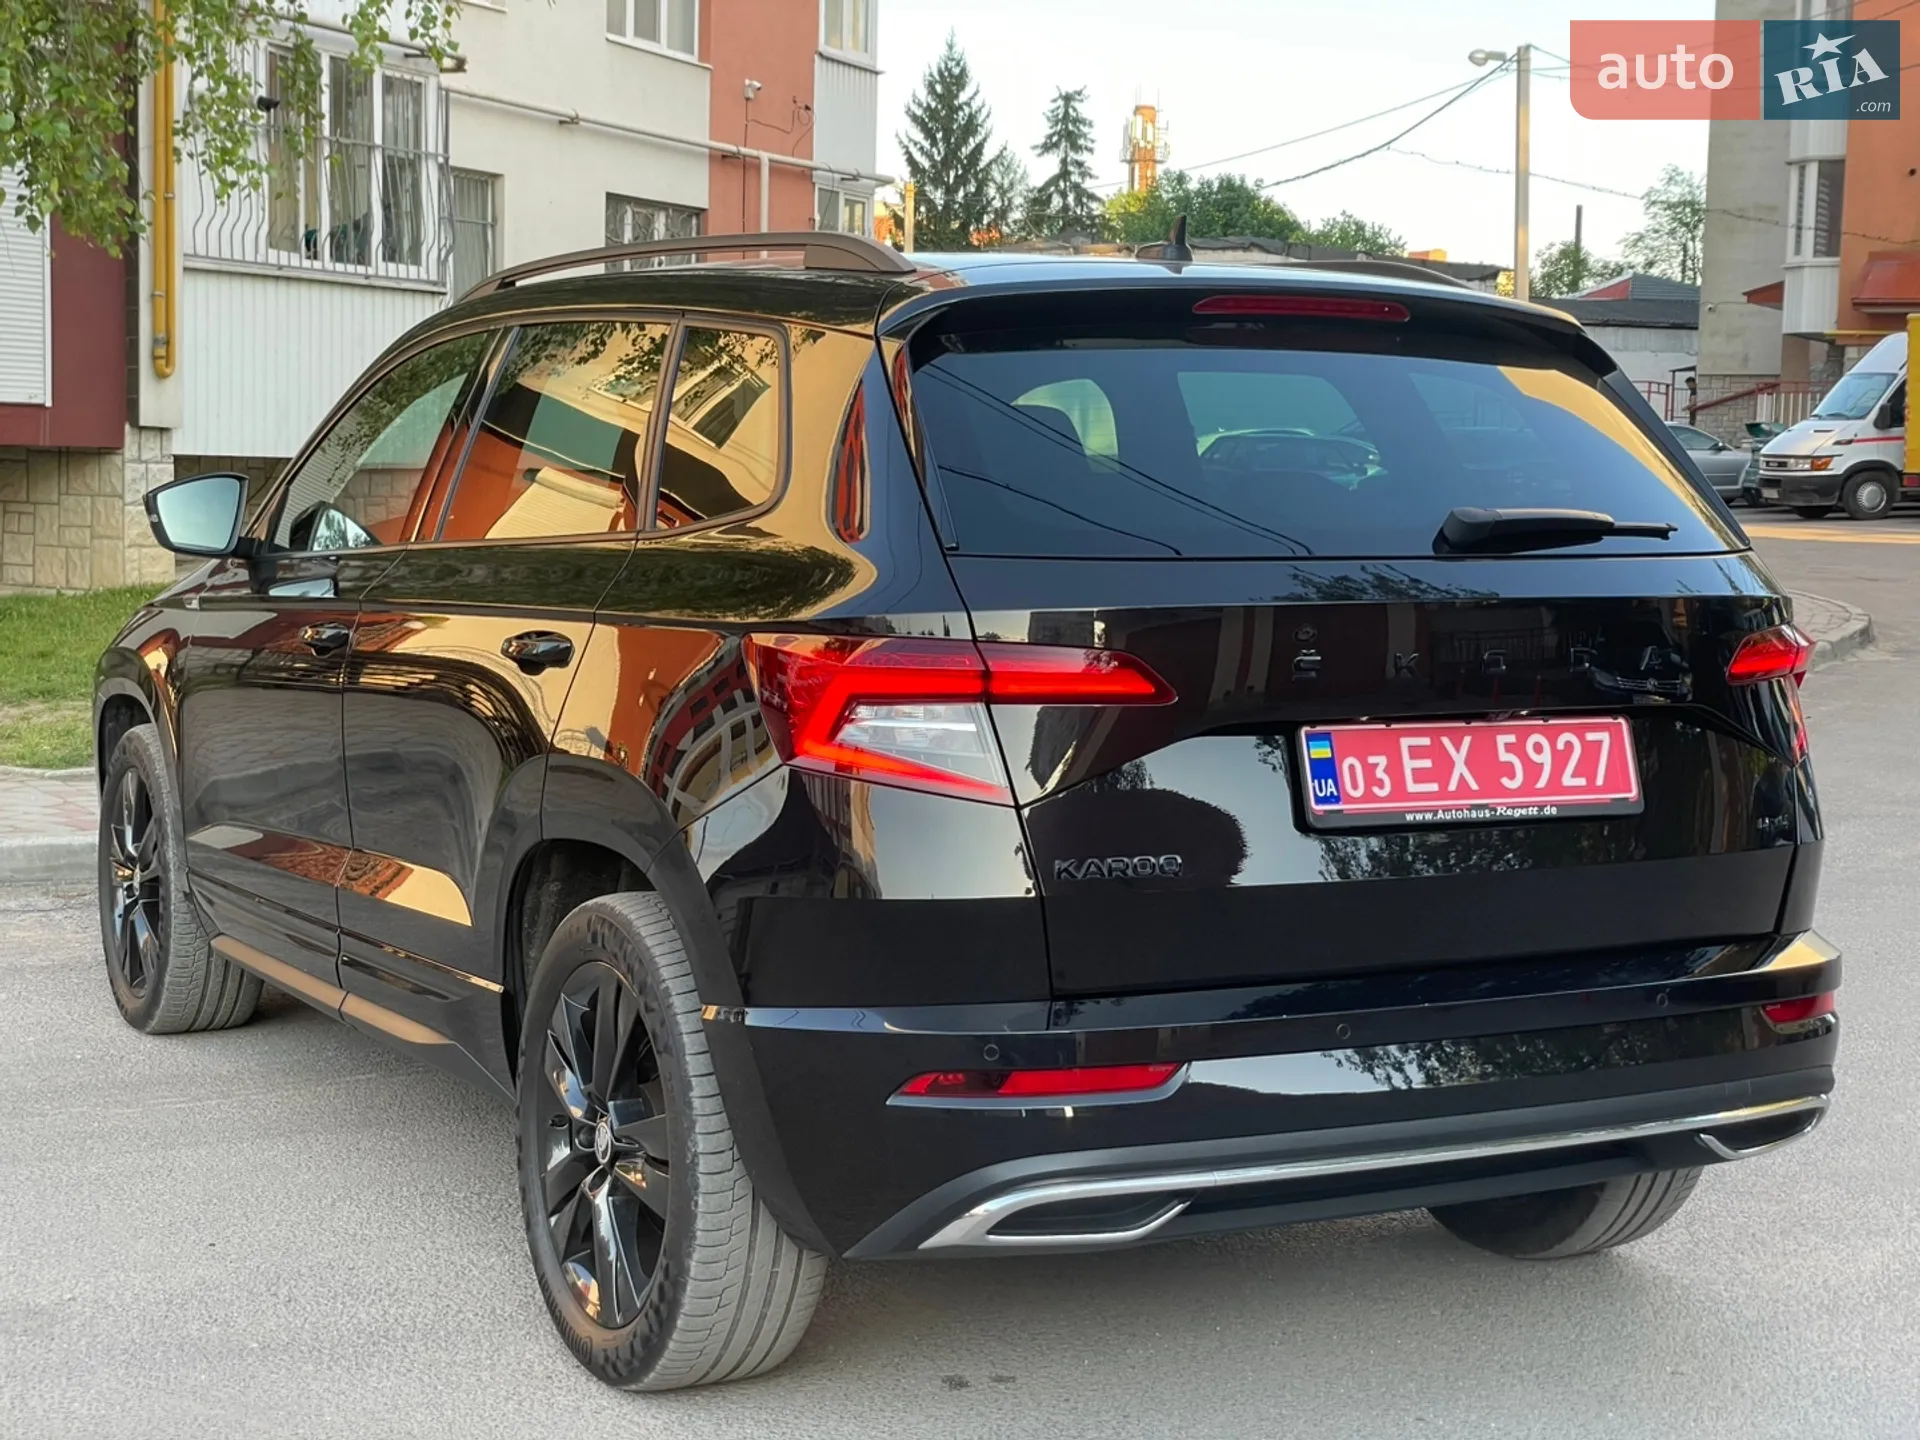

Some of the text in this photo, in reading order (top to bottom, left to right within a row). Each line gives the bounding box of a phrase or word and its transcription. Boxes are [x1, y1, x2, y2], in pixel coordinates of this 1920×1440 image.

[1342, 730, 1611, 798] 03 EX 5927
[1314, 778, 1338, 798] UA
[1053, 854, 1182, 880] KAROQ
